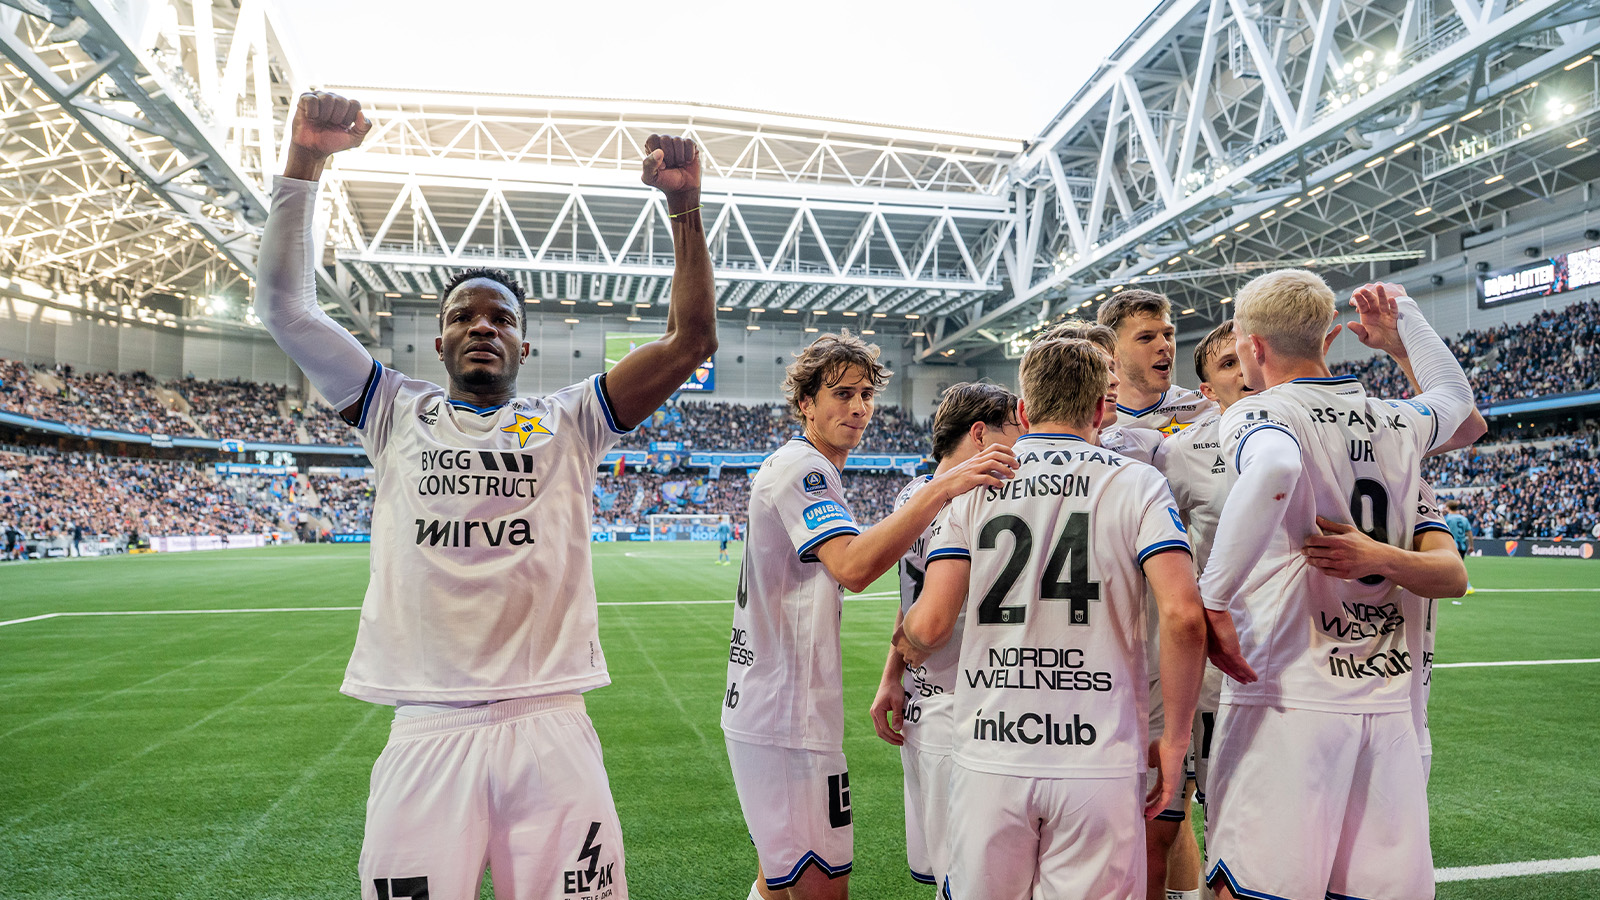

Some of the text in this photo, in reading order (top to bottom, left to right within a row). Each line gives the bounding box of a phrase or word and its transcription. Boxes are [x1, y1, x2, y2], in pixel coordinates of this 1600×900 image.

[421, 449, 471, 471] BYGG
[1076, 450, 1122, 467] TAK
[418, 474, 537, 498] CONSTRUCT
[986, 473, 1090, 502] SVENSSON
[415, 518, 535, 548] mirva
[1531, 544, 1580, 557] Sundström
[977, 511, 1101, 626] 24
[989, 647, 1084, 669] NORDIC
[965, 669, 1113, 692] WELLNESS
[974, 708, 1097, 746] inkClub
